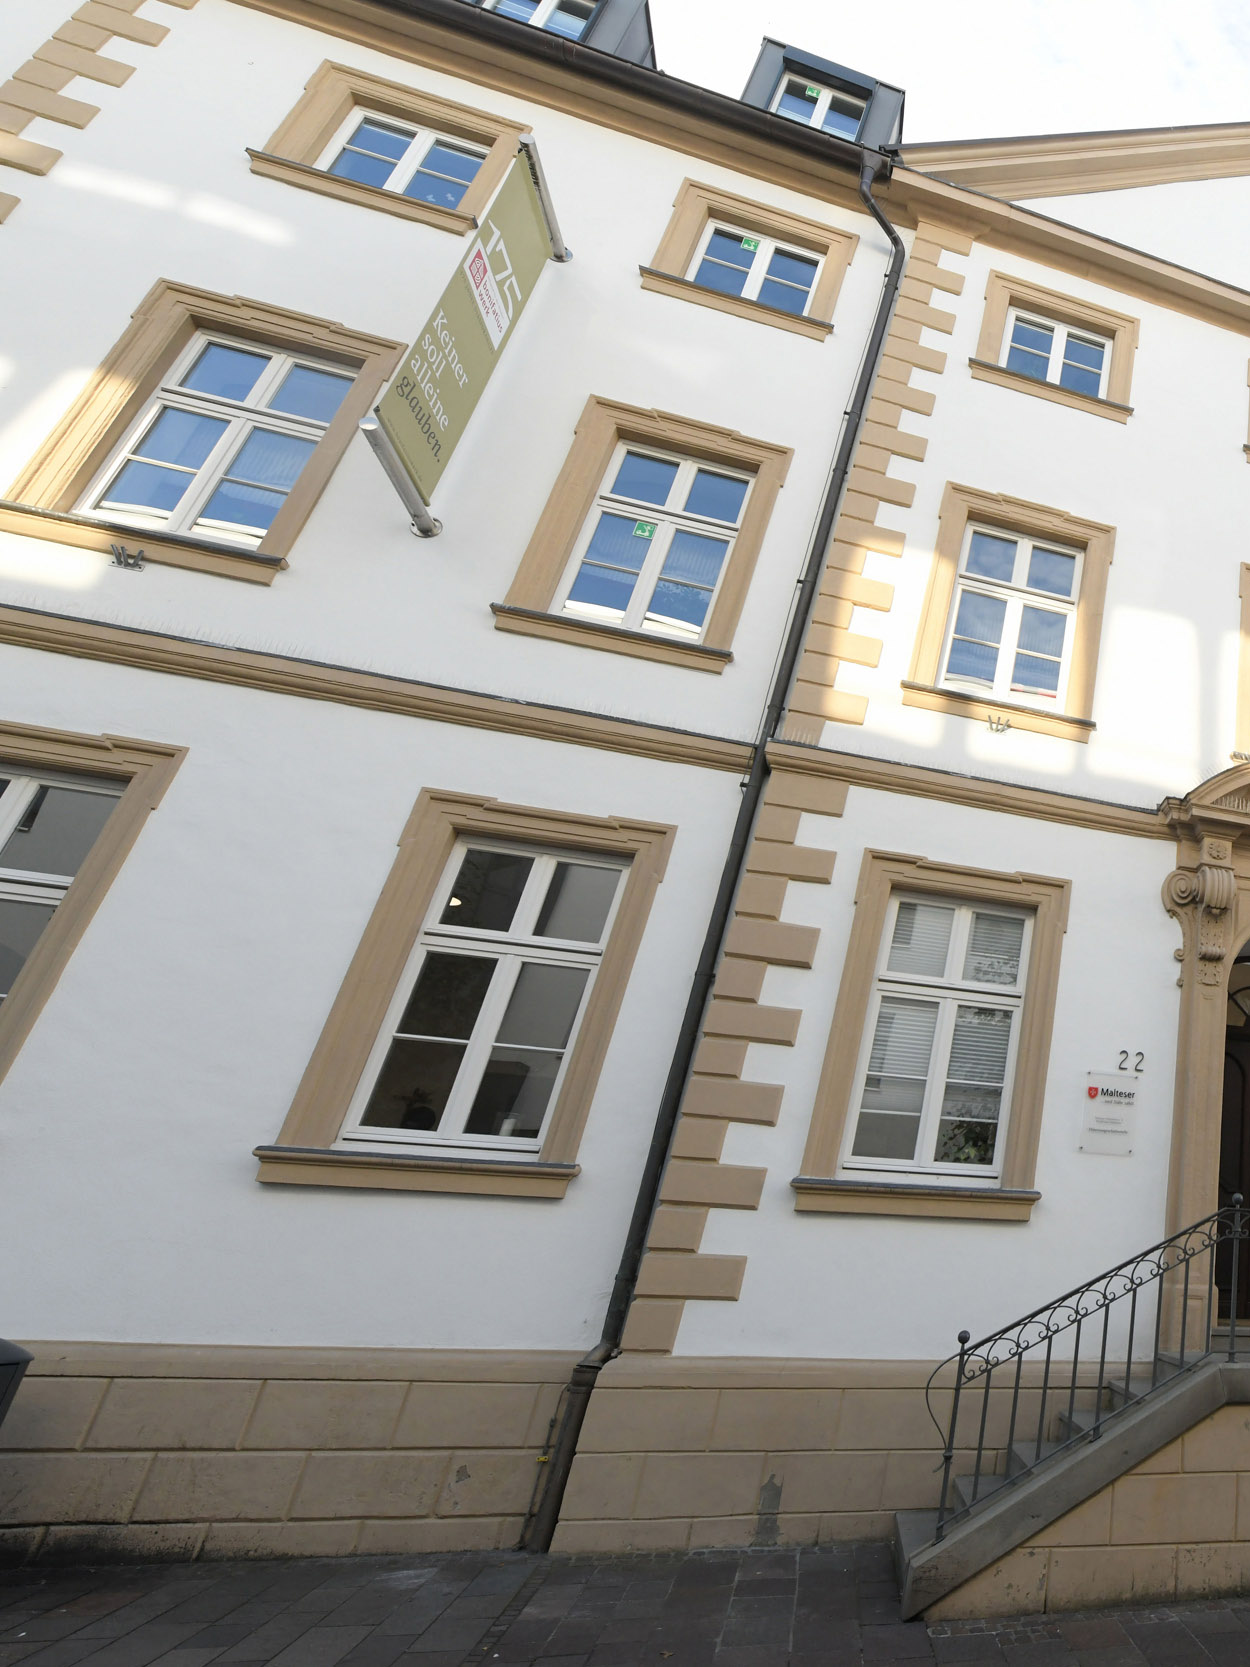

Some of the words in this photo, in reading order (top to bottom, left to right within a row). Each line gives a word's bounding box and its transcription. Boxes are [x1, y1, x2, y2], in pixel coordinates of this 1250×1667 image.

[486, 219, 522, 320] 175
[478, 289, 491, 317] werk
[482, 280, 503, 333] bonifatius
[421, 334, 447, 380] soll
[433, 308, 469, 389] Keiner
[396, 375, 442, 463] glauben.
[411, 355, 449, 432] alleine
[1118, 1049, 1145, 1072] 22
[1100, 1088, 1136, 1099] Malteser
